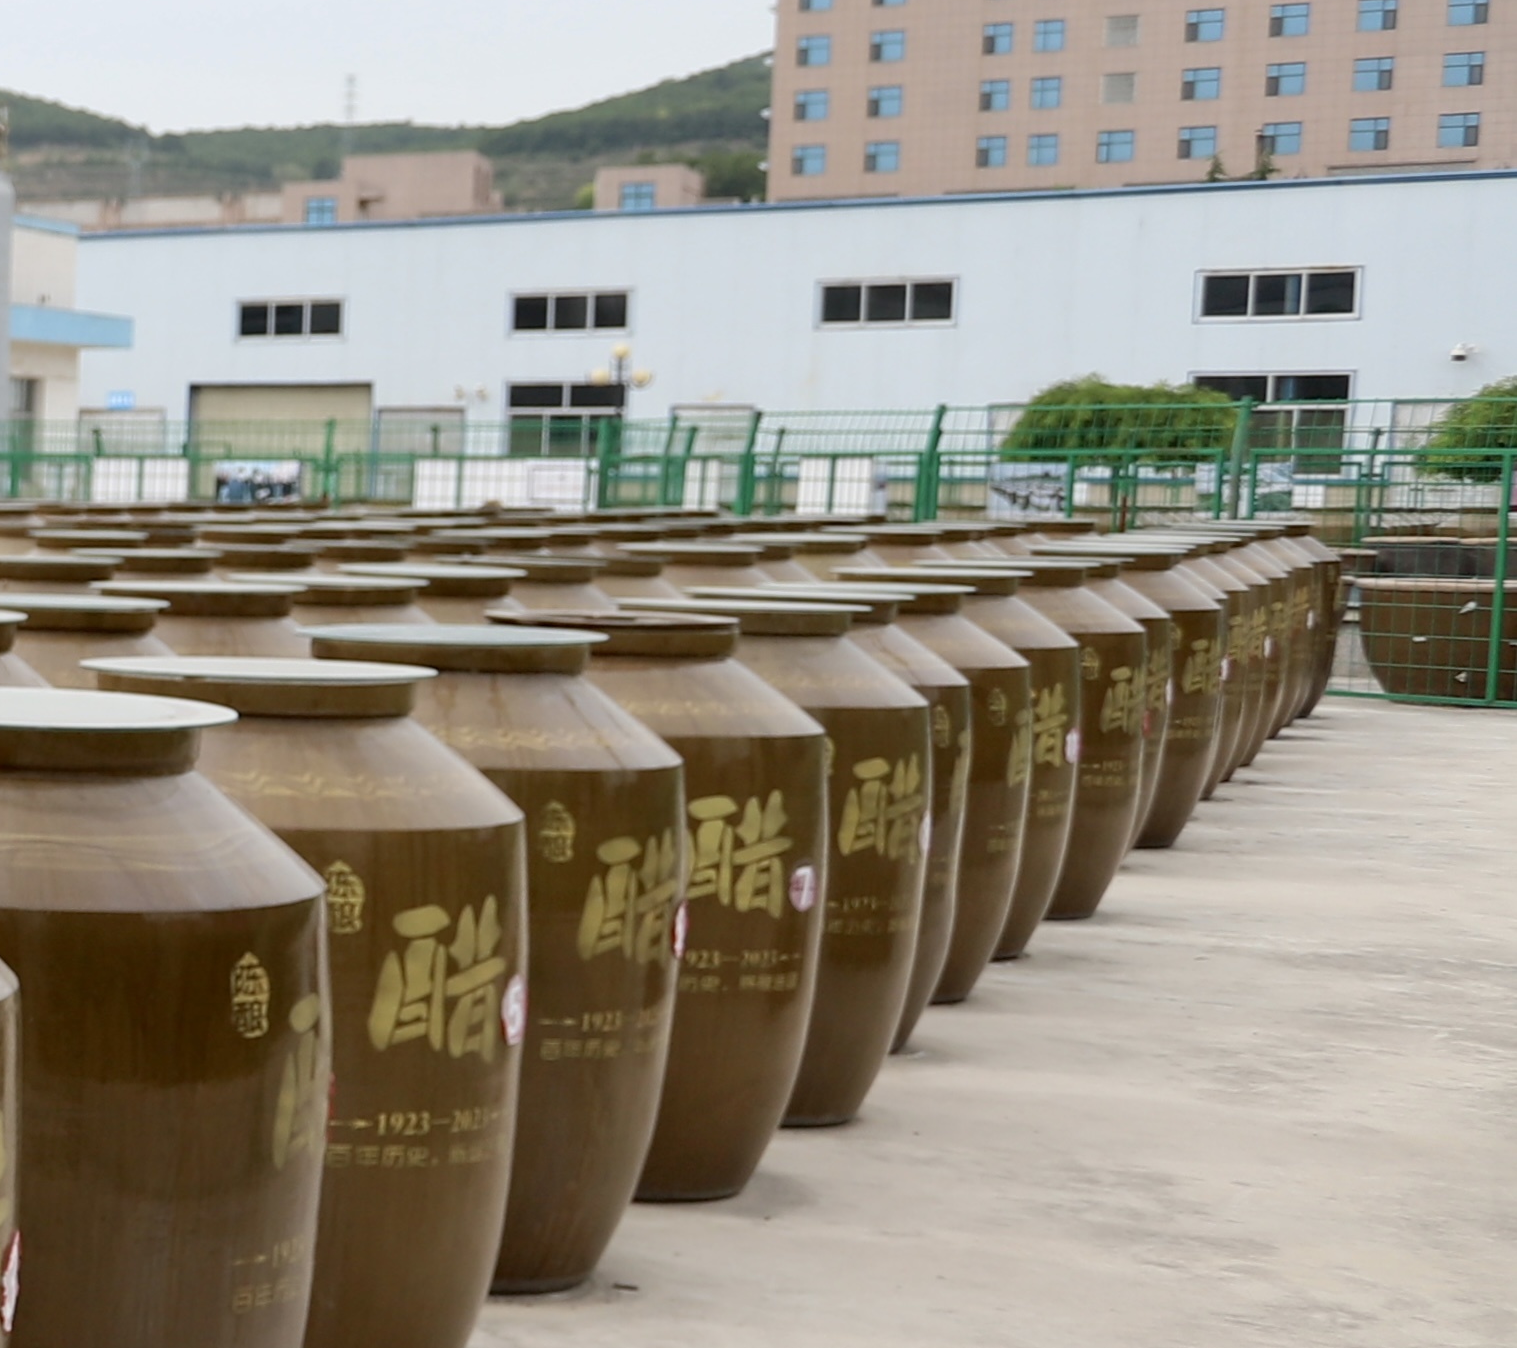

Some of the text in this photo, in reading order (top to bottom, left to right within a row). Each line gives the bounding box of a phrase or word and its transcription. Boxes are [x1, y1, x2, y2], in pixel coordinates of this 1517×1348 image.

[686, 789, 793, 919] 醋
[838, 752, 924, 865] 醋
[577, 827, 678, 964] 醋
[230, 952, 270, 1039] 陈酿
[368, 894, 507, 1063] 醋
